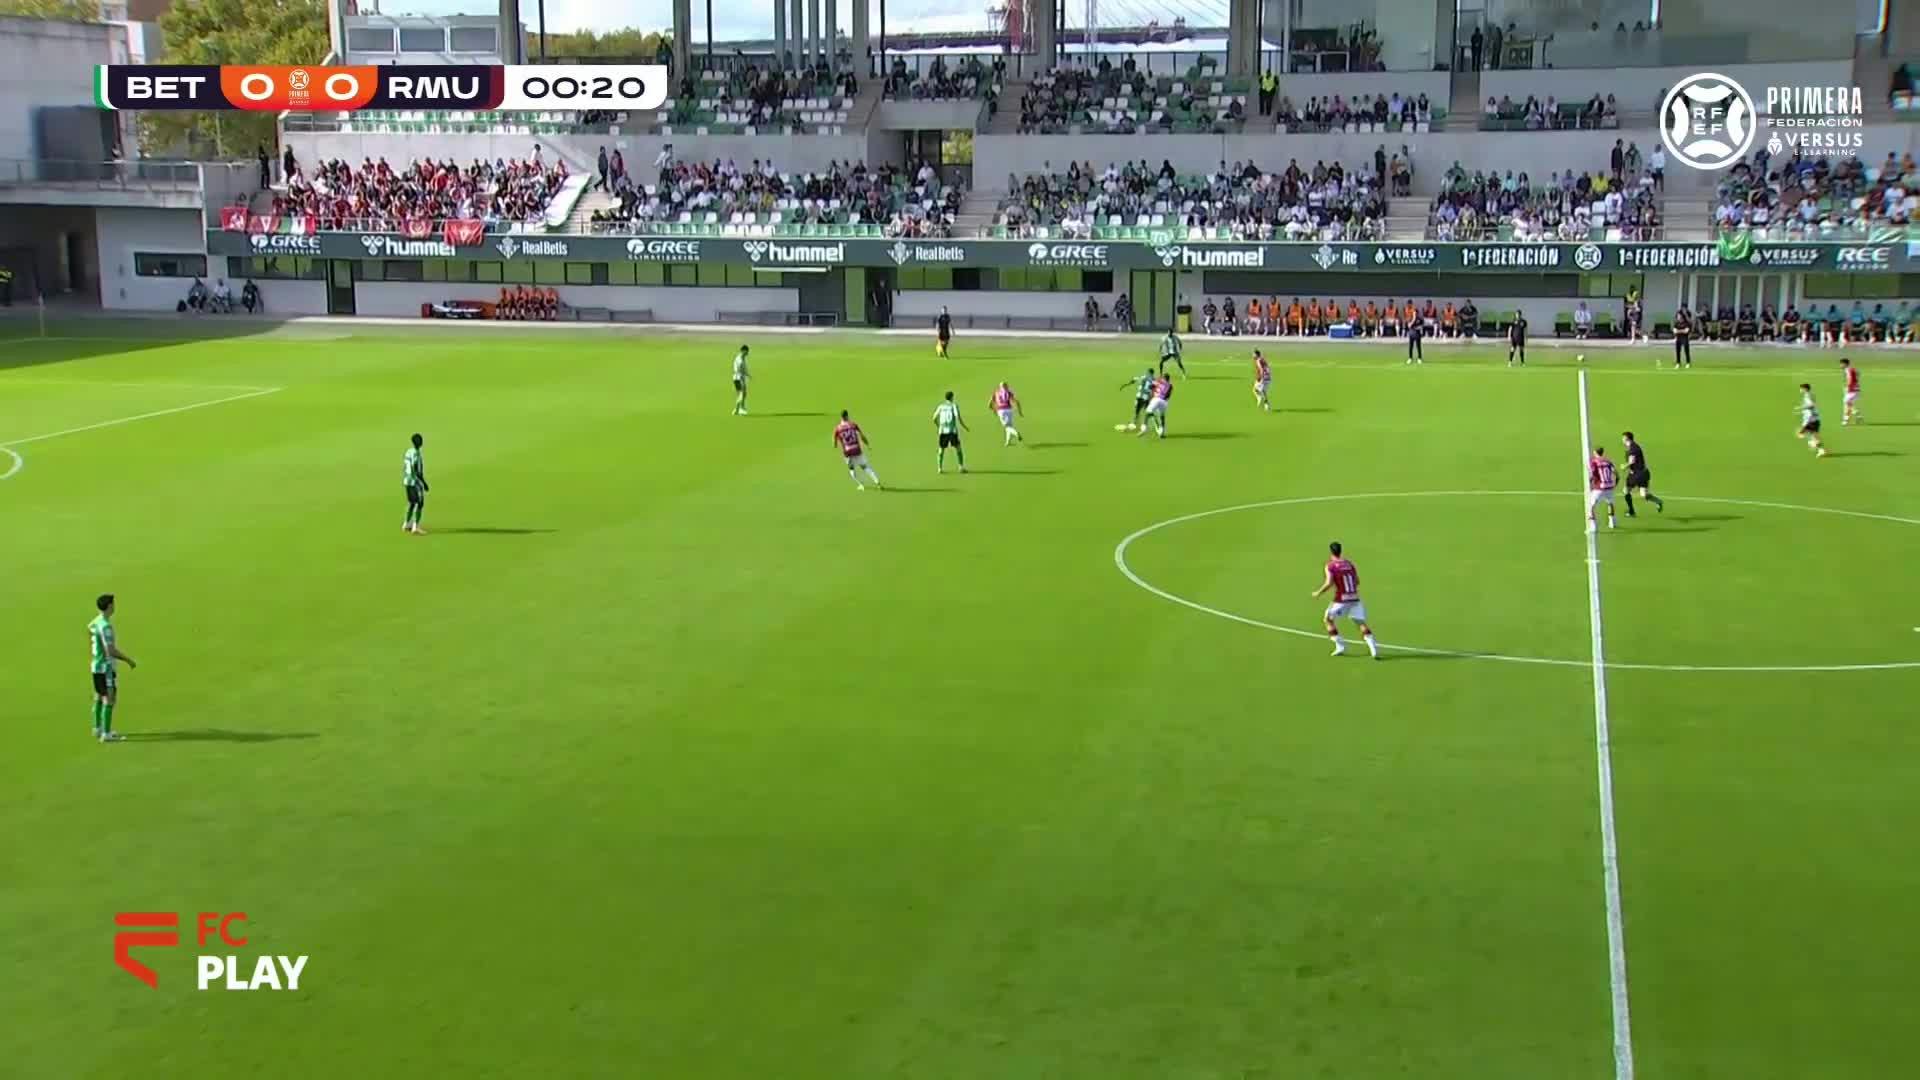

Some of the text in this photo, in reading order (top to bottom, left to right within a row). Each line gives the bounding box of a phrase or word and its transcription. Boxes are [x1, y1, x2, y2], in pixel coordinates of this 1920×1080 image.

[271, 235, 321, 248] GREE
[385, 236, 456, 256] hummel
[647, 241, 700, 255] GREE
[769, 241, 844, 261] hummel
[1051, 245, 1108, 259] GREE
[1182, 246, 1264, 266] hummel
[1342, 249, 1358, 265] Re
[1386, 248, 1435, 259] VERSUS
[1478, 244, 1559, 266] FEDERACIÓN
[1635, 245, 1720, 266] FEDERACIÓN
[1762, 249, 1819, 260] VERSUS
[1837, 246, 1890, 262] REE
[1343, 575, 1355, 593] 11
